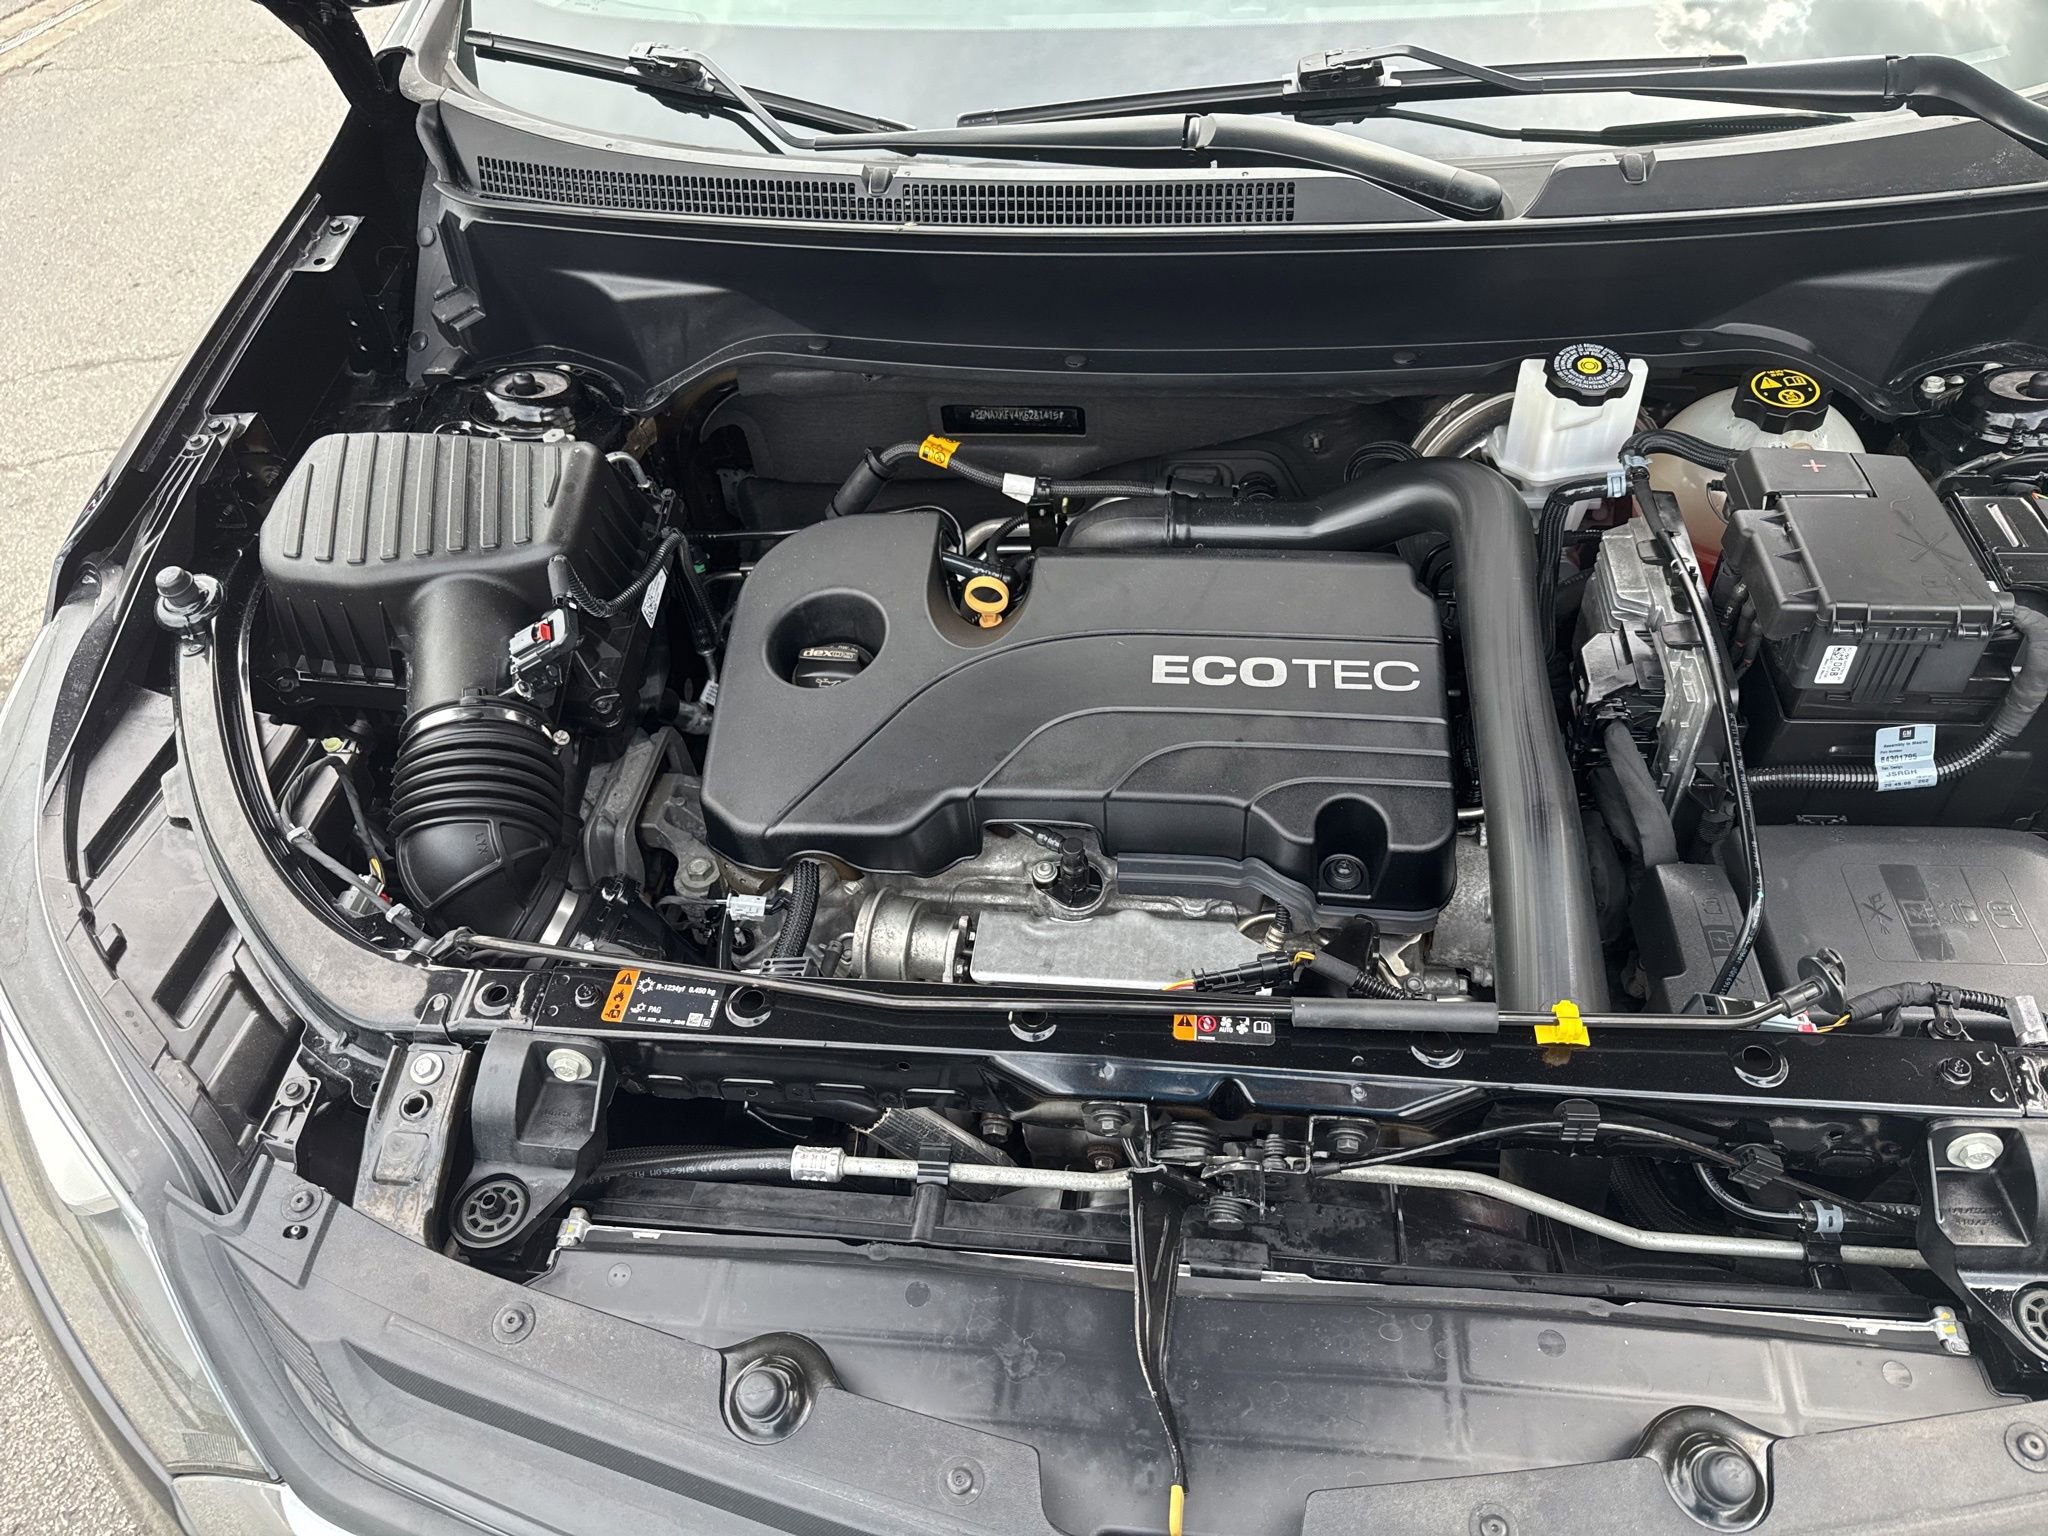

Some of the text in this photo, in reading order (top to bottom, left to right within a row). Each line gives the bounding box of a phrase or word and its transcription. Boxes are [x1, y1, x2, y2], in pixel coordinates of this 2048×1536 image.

[802, 649, 856, 660] dexos
[1152, 654, 1421, 692] ECOTEC
[1902, 729, 1912, 738] GM
[707, 987, 717, 997] kg
[647, 1005, 662, 1014] PAG
